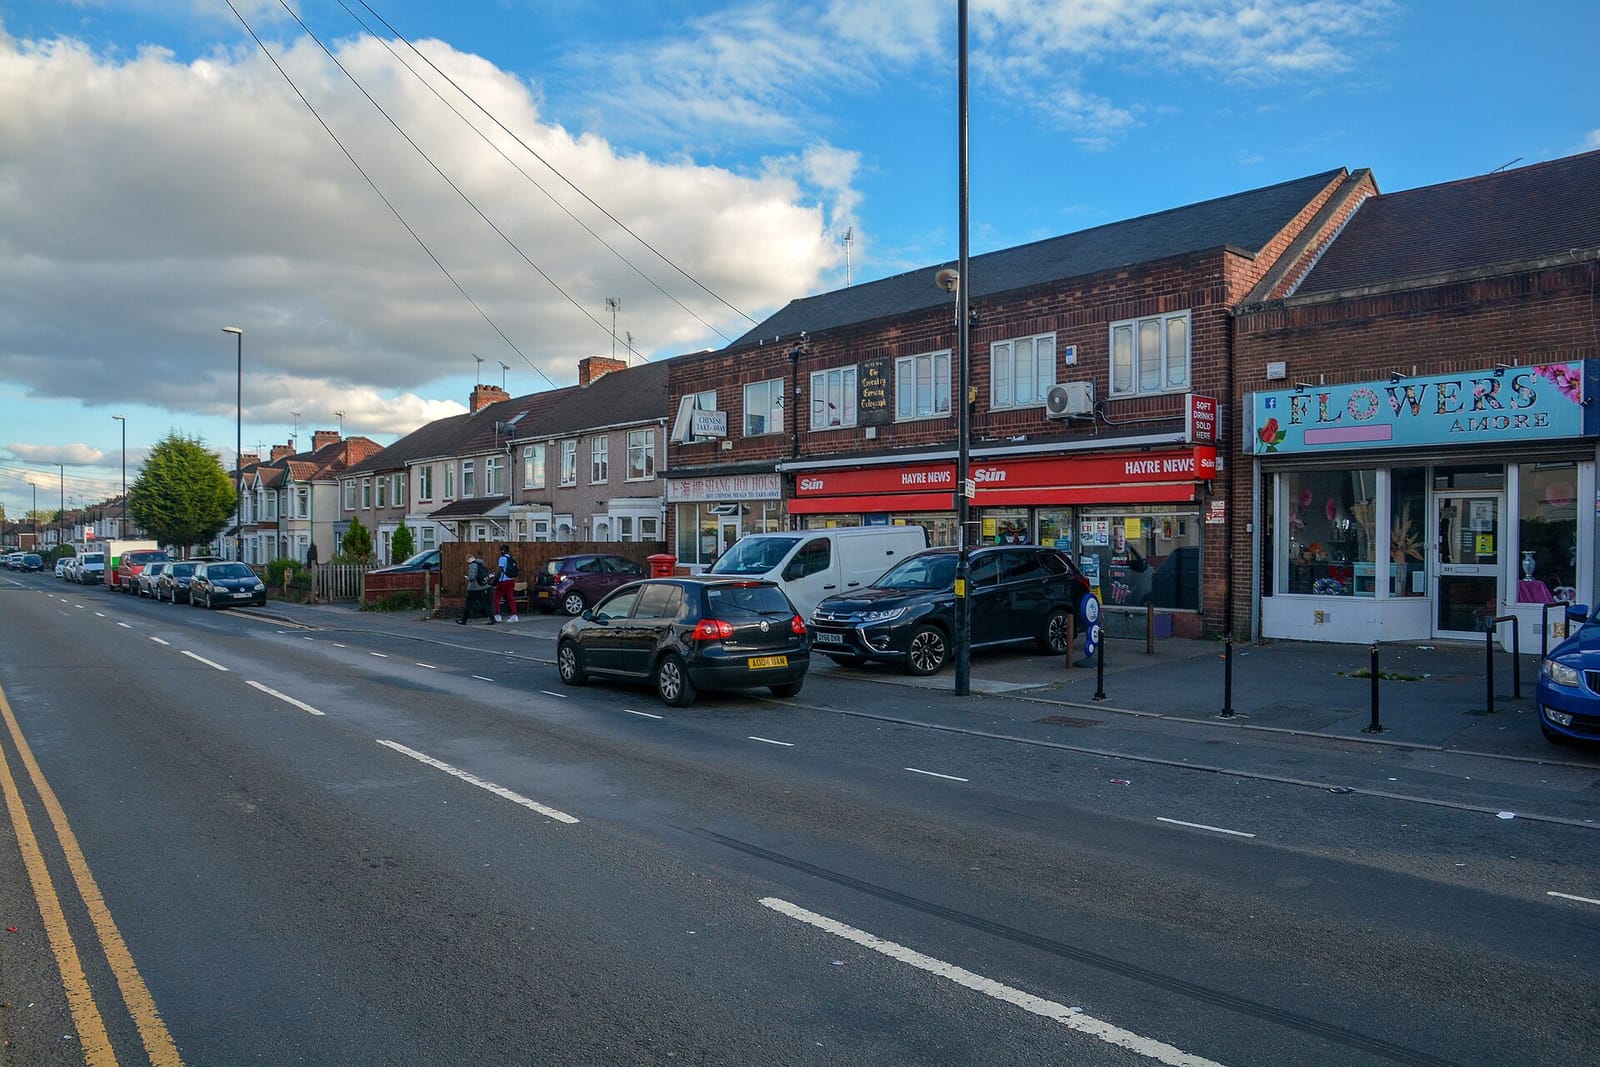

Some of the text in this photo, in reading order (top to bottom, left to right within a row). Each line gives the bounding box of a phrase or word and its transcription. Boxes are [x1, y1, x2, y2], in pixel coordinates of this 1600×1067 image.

[1196, 401, 1211, 410] SOFT
[1288, 373, 1537, 425] FLOWERS
[1193, 411, 1214, 421] DRINKS
[1449, 412, 1550, 433] AMORE
[1196, 421, 1211, 430] SOLD
[1196, 431, 1211, 439] HERE
[1125, 459, 1194, 474] HAYRE NEWS
[705, 478, 730, 492] SHANG
[752, 475, 780, 491] HOUSE
[902, 471, 950, 484] HAYRE NEWS
